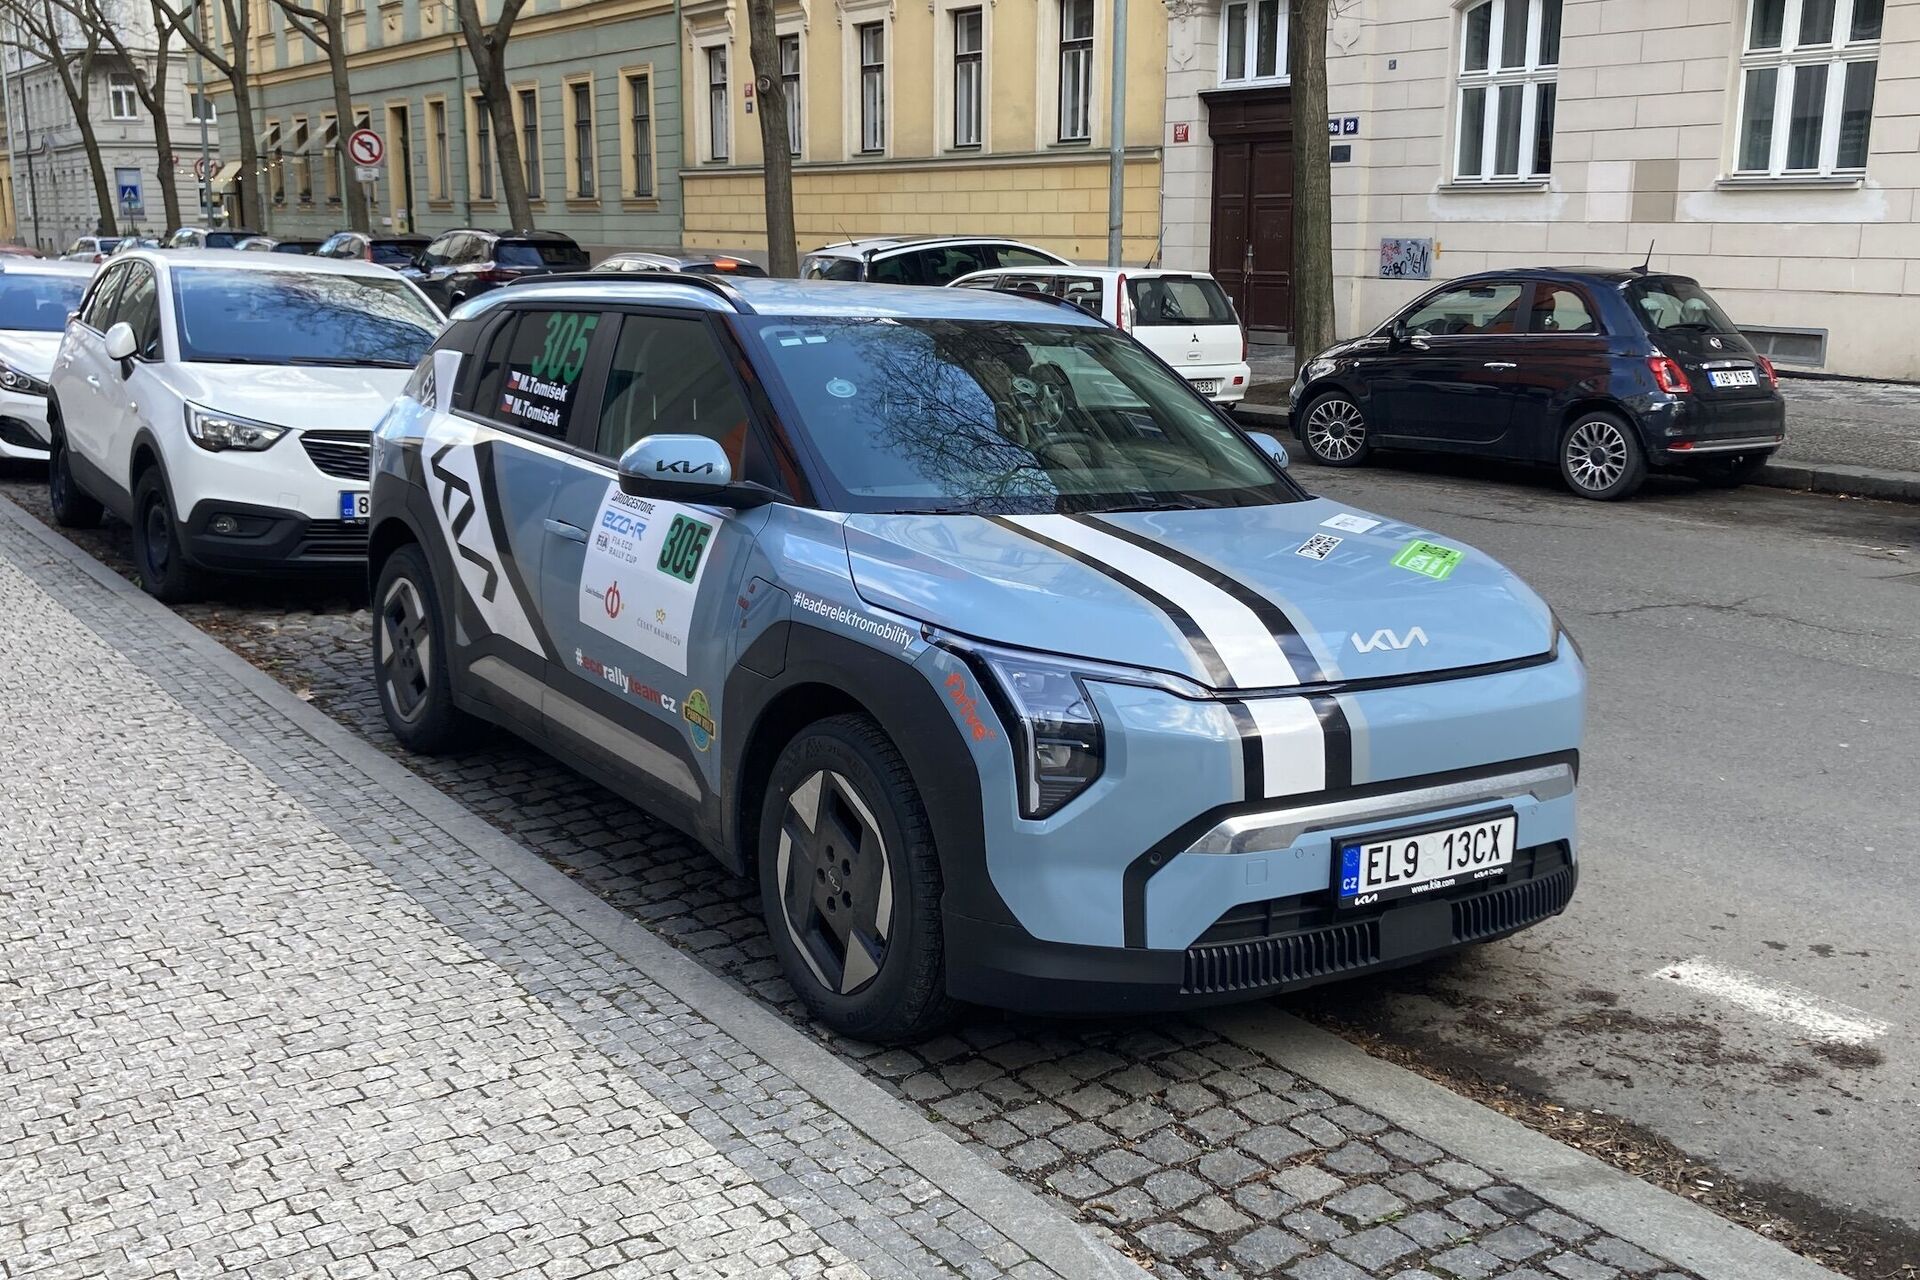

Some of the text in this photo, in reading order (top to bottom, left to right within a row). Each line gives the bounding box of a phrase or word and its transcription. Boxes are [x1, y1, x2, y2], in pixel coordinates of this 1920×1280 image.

[531, 311, 599, 384] 305
[656, 460, 713, 475] KIA
[612, 490, 656, 515] BRIDGESTONE
[660, 517, 709, 579] 305
[793, 592, 914, 649] #leaderelektromobility
[1351, 626, 1429, 653] KIA
[575, 648, 677, 713] #ecorallyteamcz
[1367, 824, 1502, 886] EL9 13CX
[1342, 877, 1357, 890] CZ
[1411, 878, 1456, 893] www.kia.com
